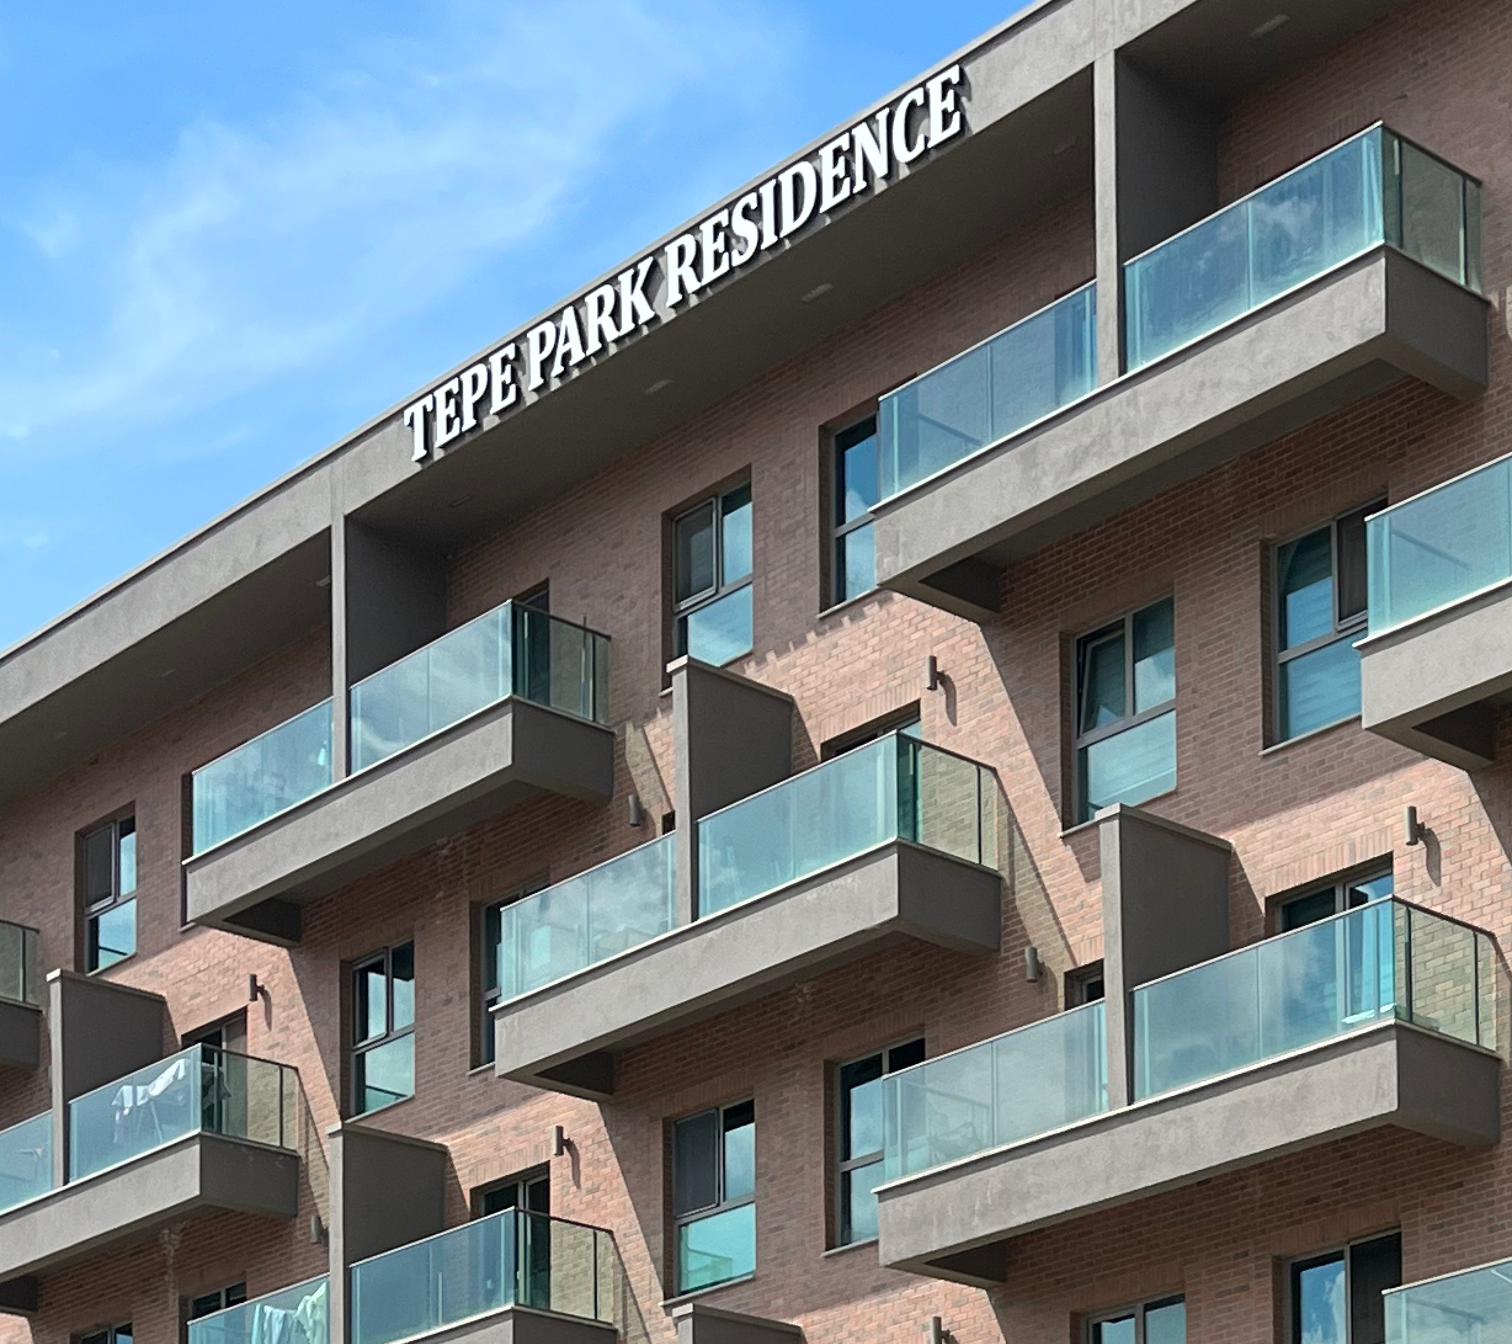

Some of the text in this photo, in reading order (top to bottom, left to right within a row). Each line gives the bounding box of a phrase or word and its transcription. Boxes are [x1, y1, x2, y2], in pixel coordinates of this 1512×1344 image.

[404, 64, 962, 462] TEPE PARK RESIDENCE
